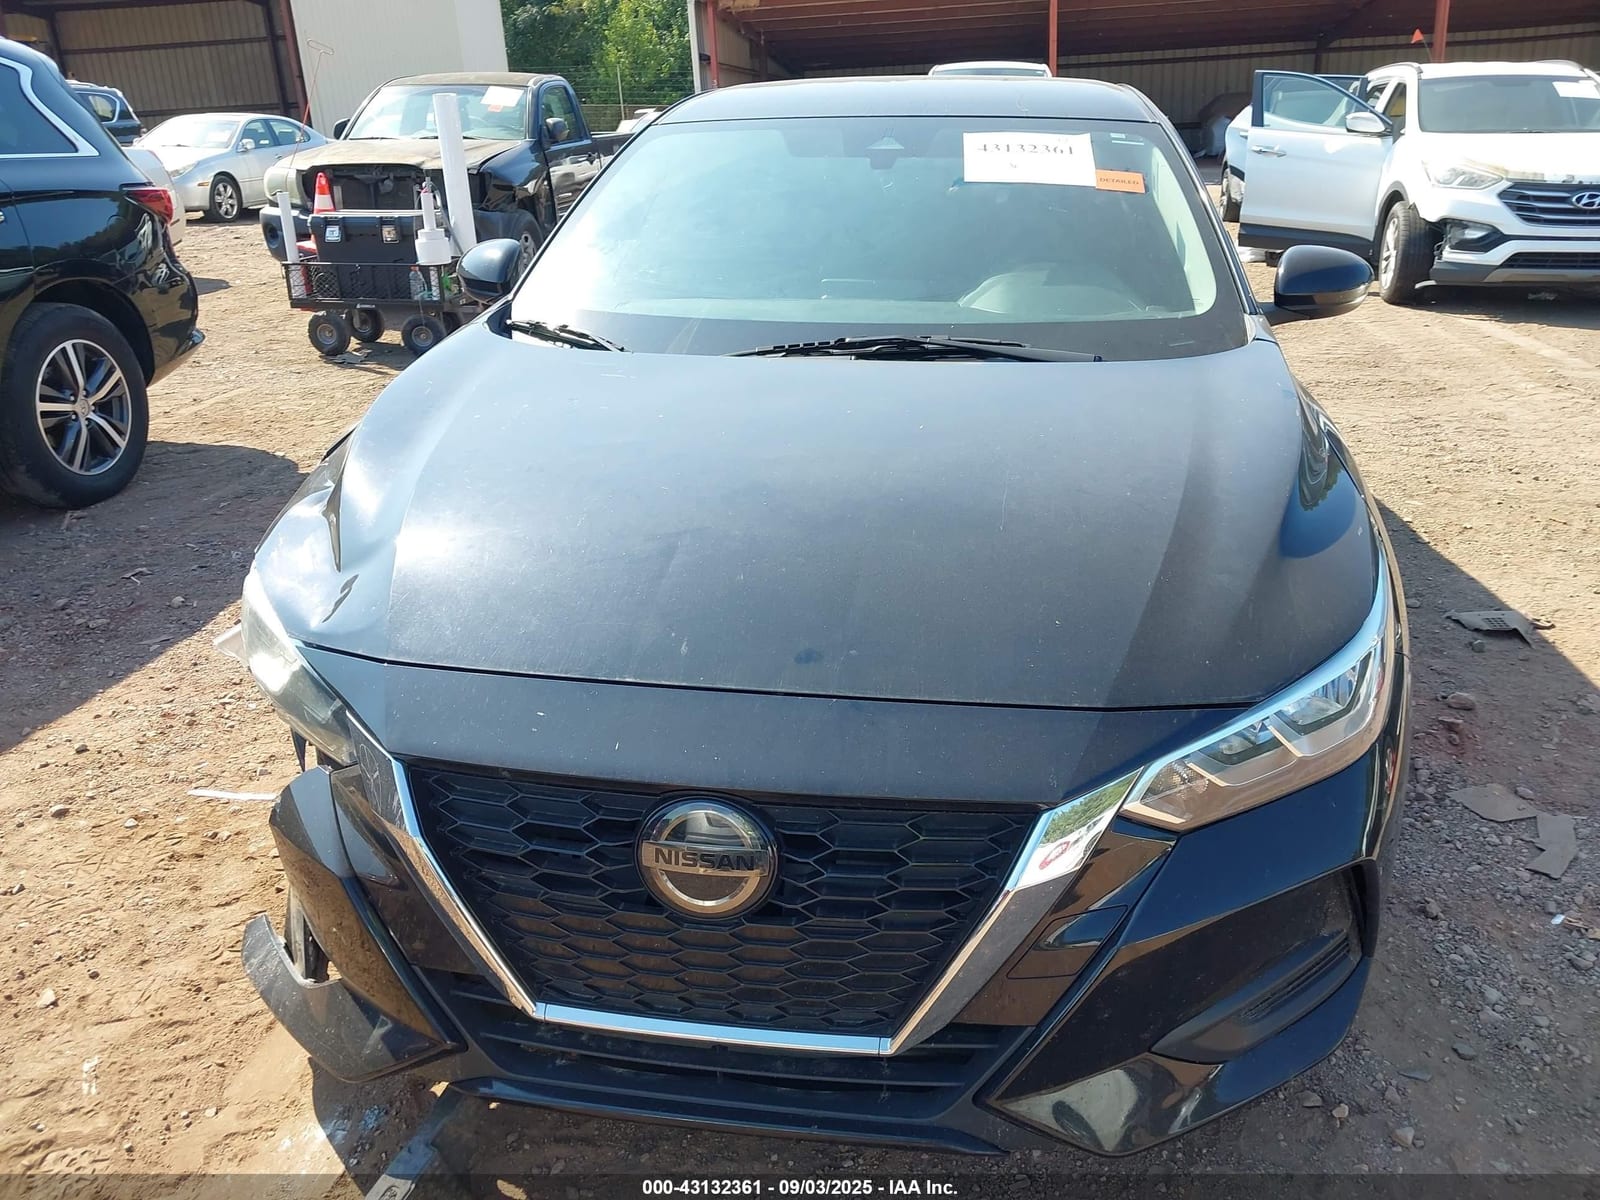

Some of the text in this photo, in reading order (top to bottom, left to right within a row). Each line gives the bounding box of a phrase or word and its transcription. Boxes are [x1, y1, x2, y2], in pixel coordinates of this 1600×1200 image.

[977, 143, 1073, 155] 43132361
[1099, 177, 1140, 185] DETAILED
[654, 847, 754, 871] NISSAN
